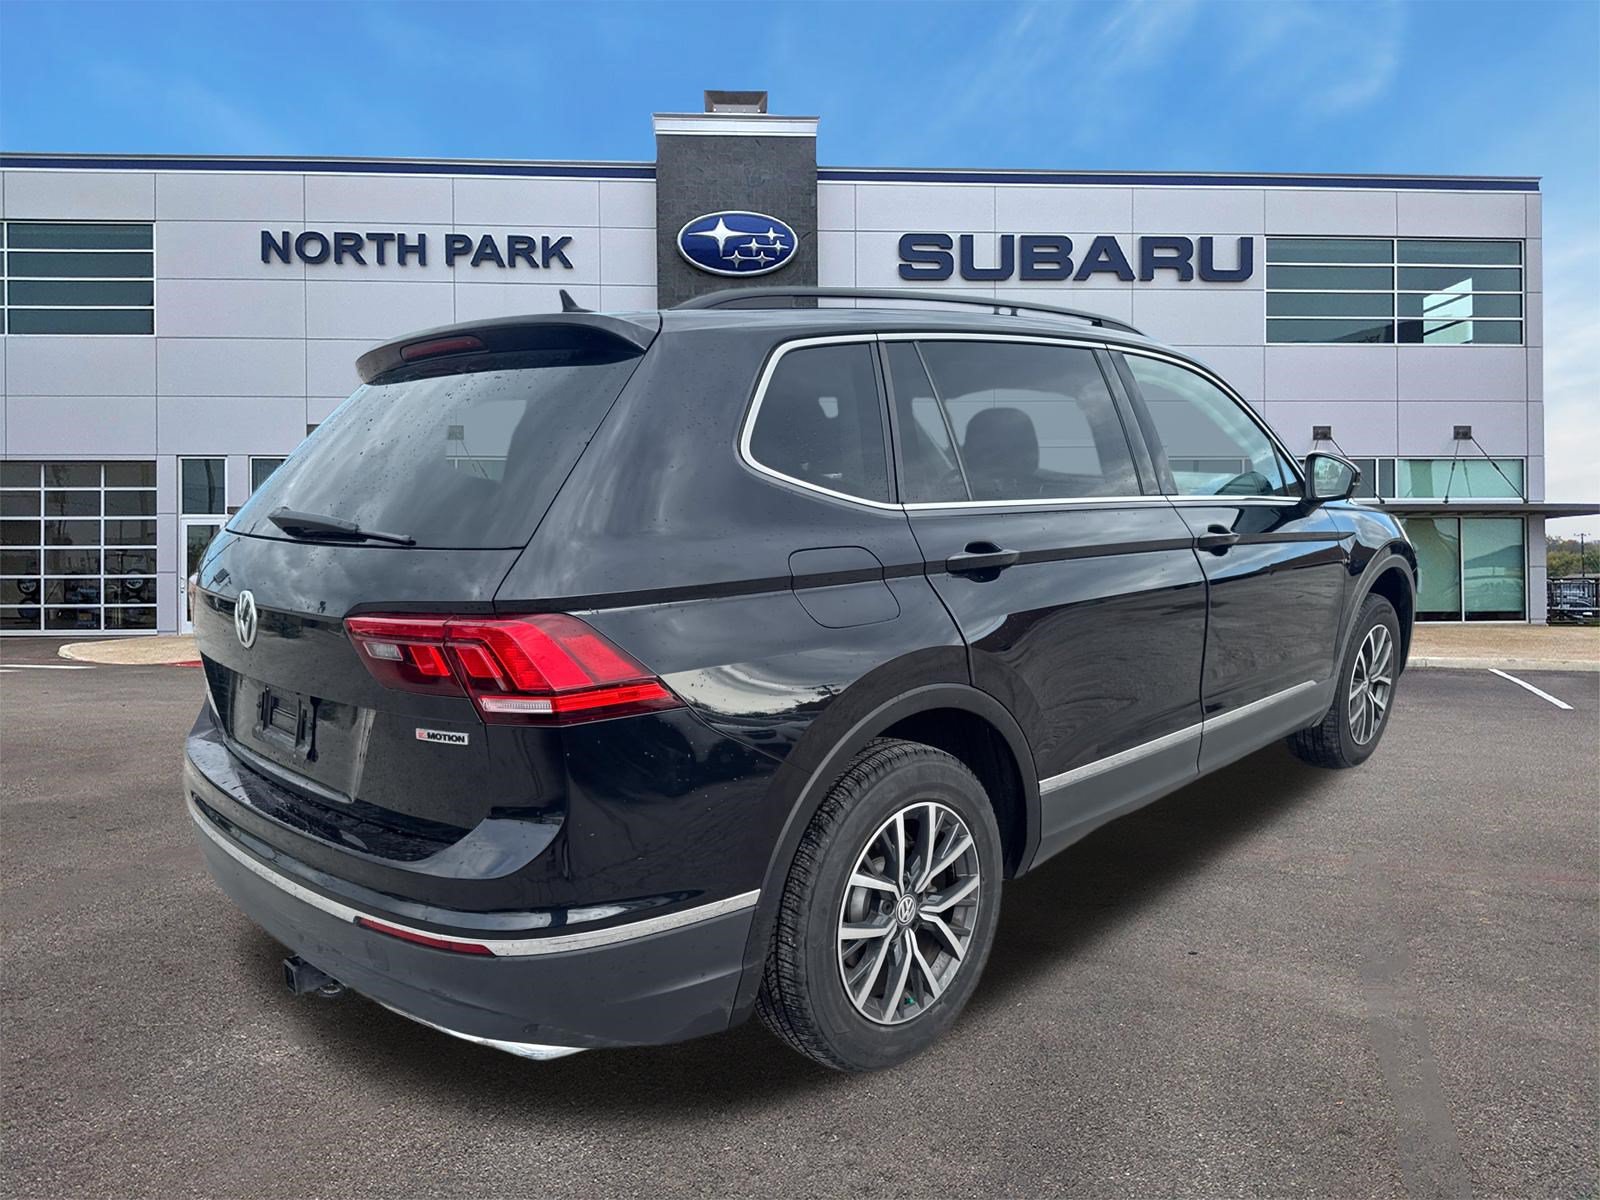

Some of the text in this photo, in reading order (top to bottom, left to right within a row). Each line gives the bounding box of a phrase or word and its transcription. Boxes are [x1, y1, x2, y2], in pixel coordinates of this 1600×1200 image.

[261, 230, 574, 269] NORTH PARK
[898, 232, 1254, 282] SUBARU
